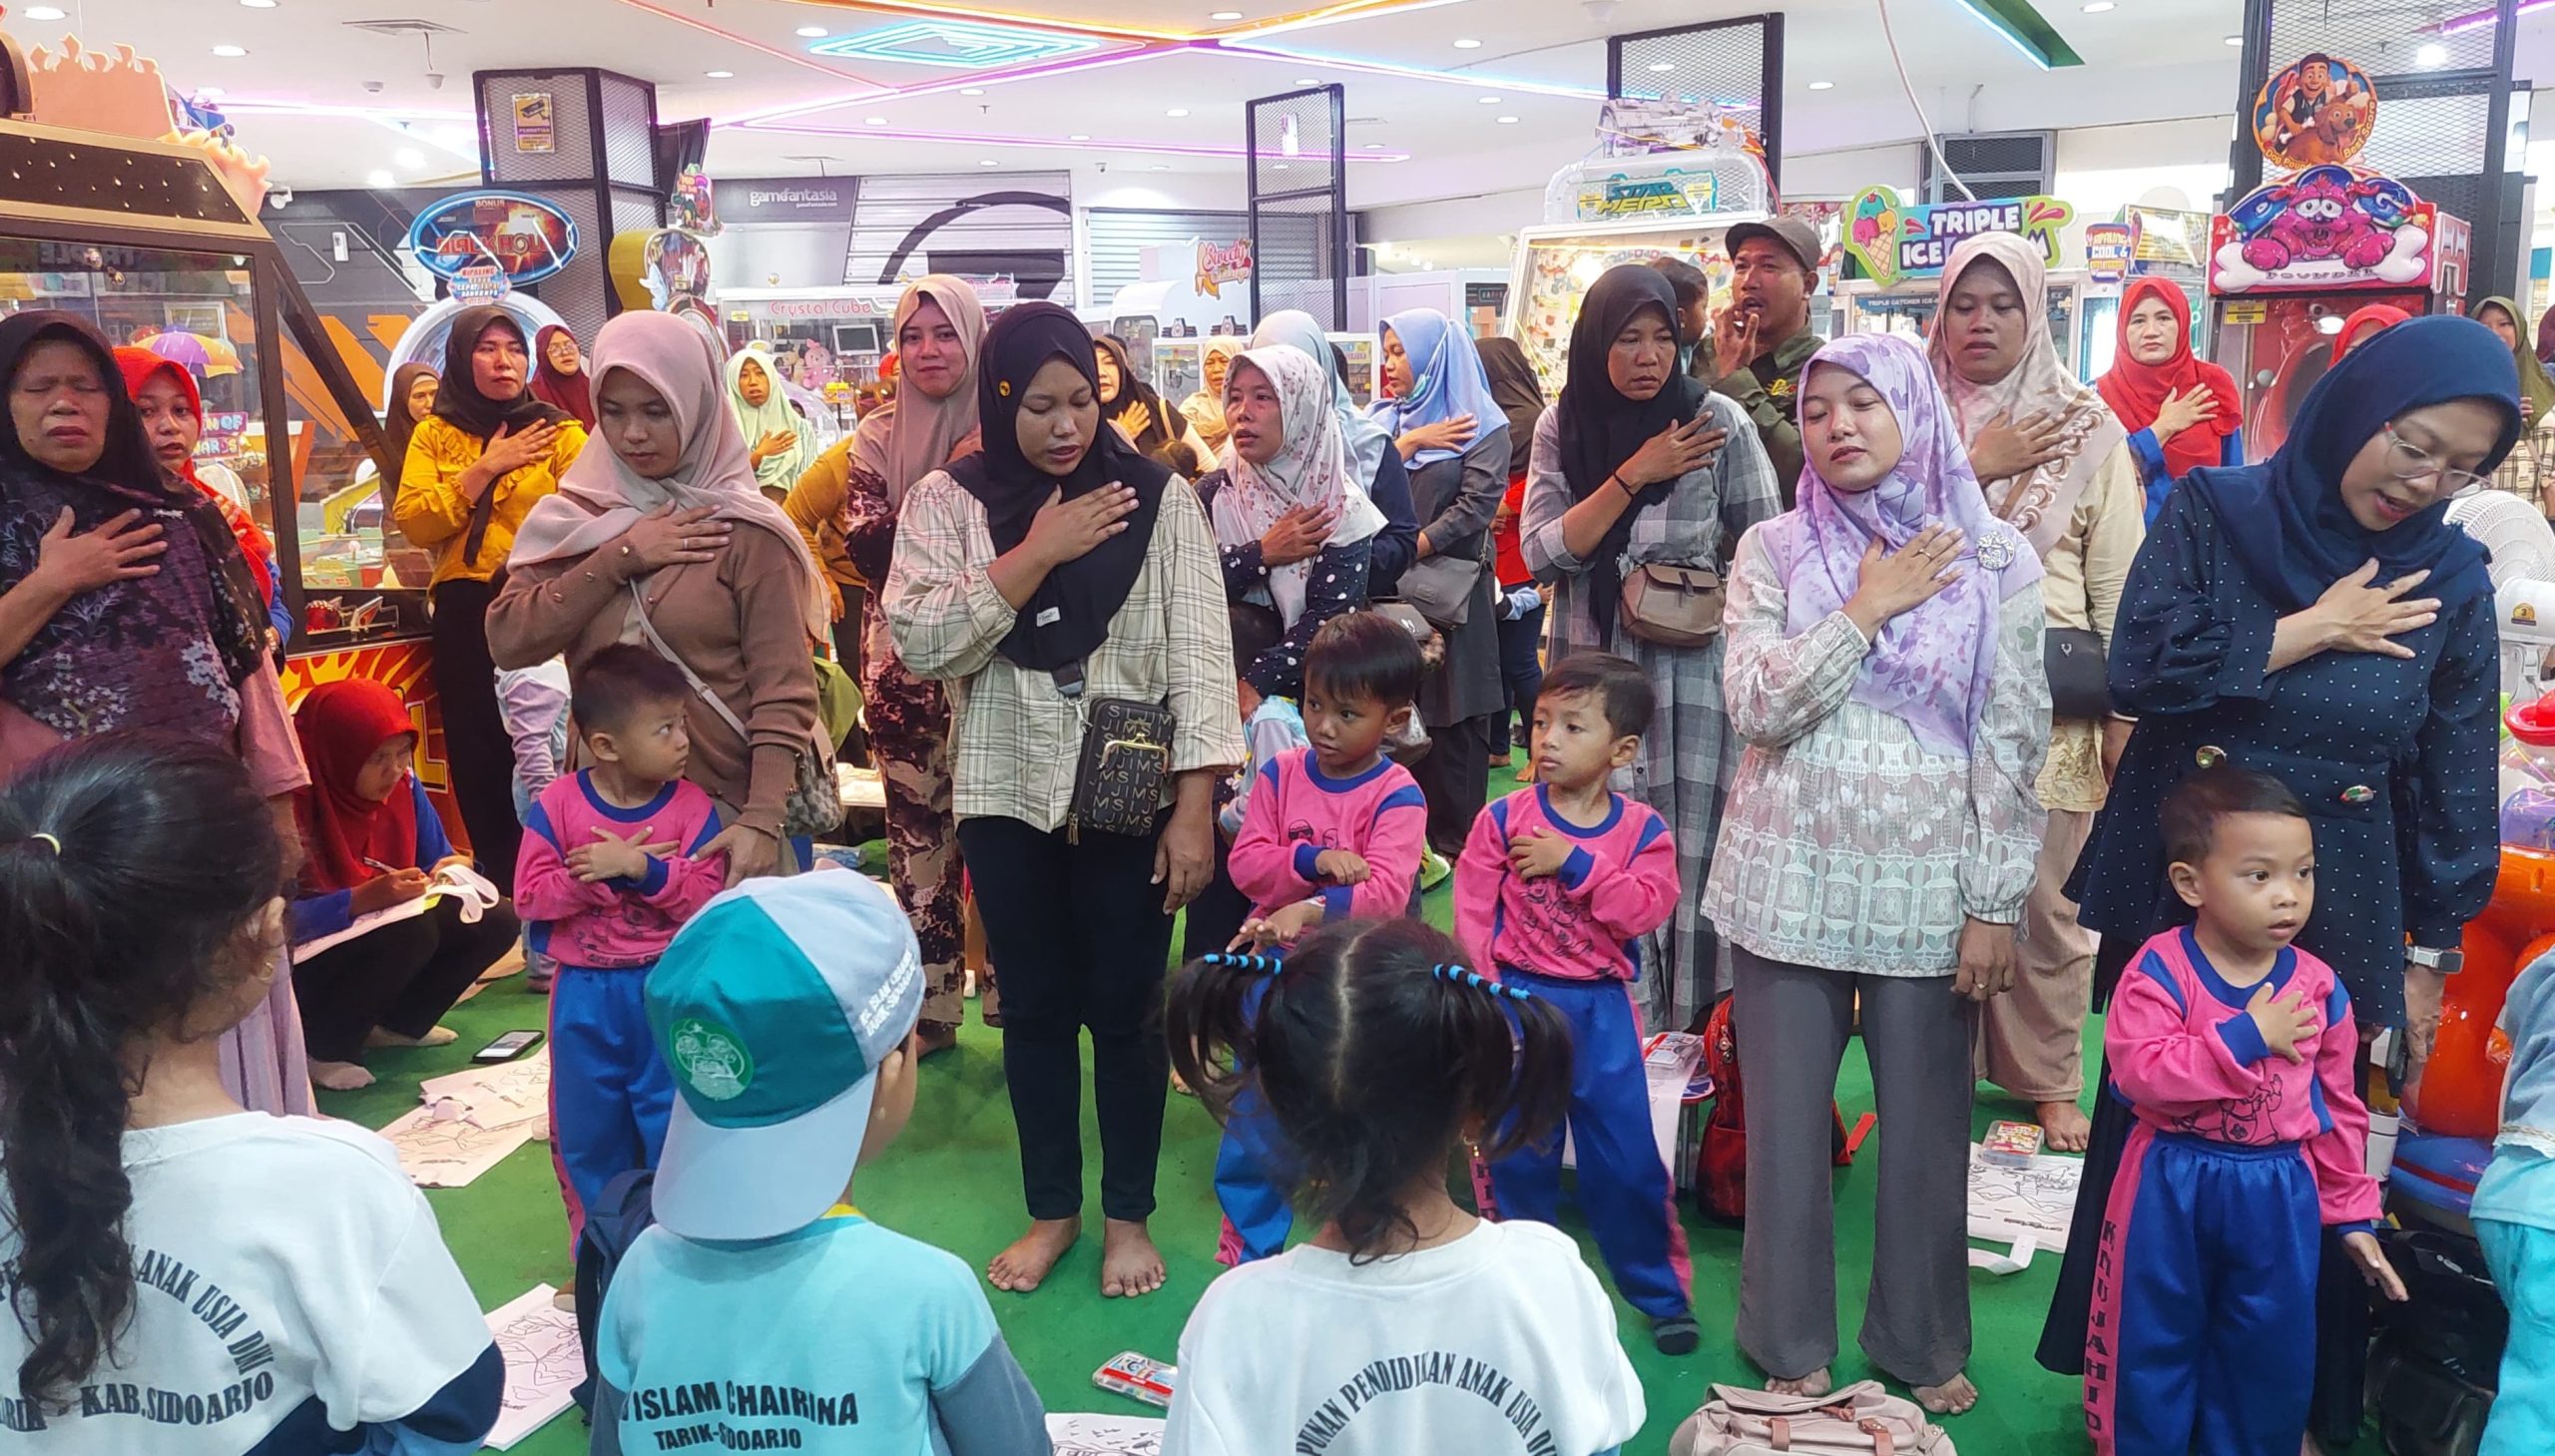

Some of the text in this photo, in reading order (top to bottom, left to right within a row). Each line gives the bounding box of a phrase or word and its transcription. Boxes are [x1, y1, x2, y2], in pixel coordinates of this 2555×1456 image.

[2342, 101, 2375, 159] Best Score
[2265, 149, 2283, 164] Dog
[1930, 208, 2020, 236] TRIPLE
[1901, 242, 1942, 267] ICE
[770, 300, 870, 317] Crystal Cube
[220, 414, 243, 430] OF
[136, 1249, 201, 1304] ANAK
[192, 1284, 249, 1340] USIA
[633, 1381, 722, 1422] ISLAM
[1455, 1357, 1513, 1407] ANAK
[1505, 1389, 1542, 1440] USIA
